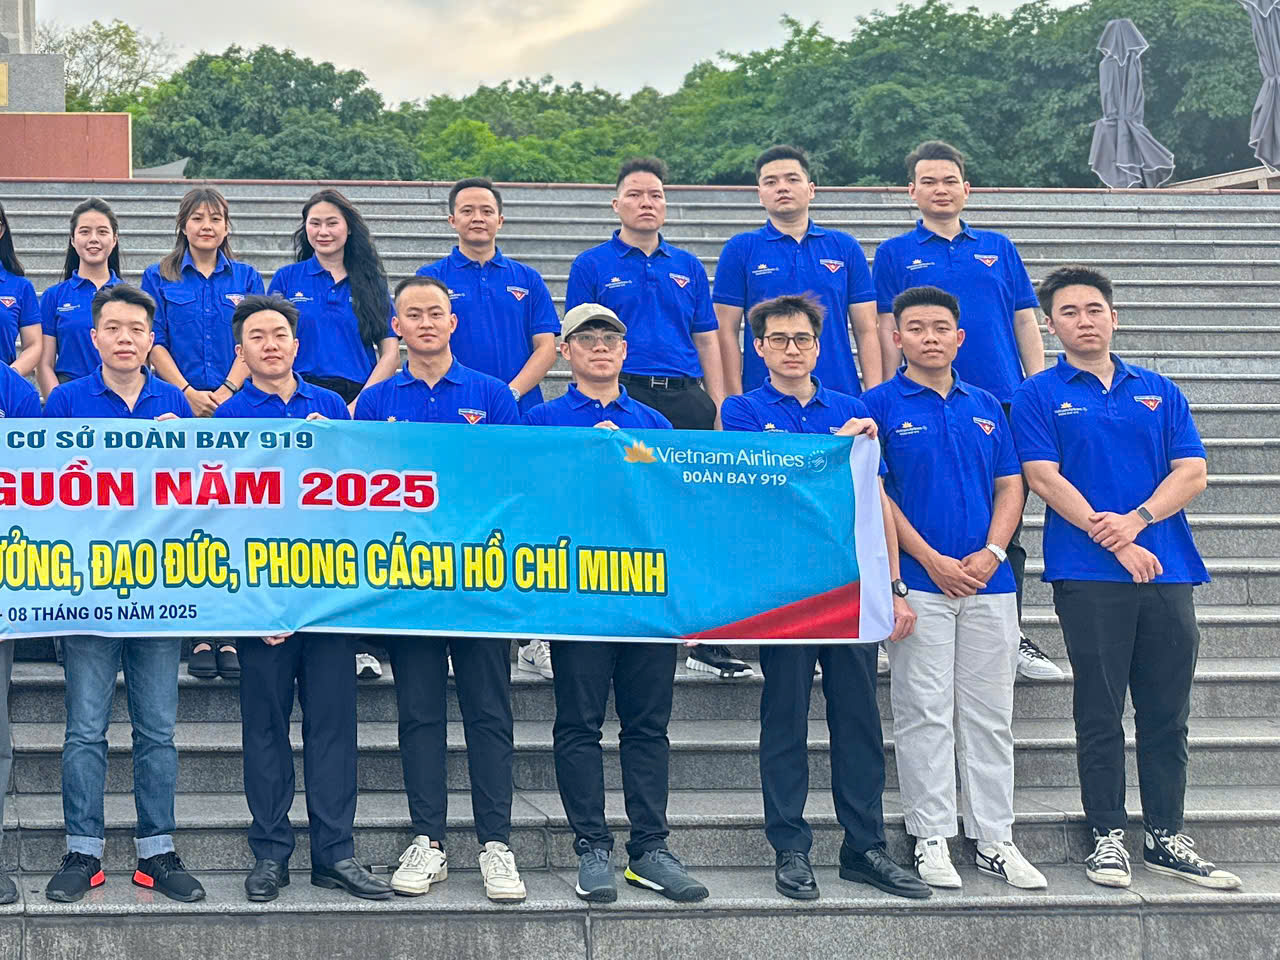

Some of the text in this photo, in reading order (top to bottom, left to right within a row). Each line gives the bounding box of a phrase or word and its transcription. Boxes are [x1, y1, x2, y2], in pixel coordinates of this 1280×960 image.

[6, 428, 46, 449] CƠ
[55, 424, 96, 450] SỞ
[103, 426, 186, 450] ĐOÀN
[195, 430, 250, 449] BAY
[259, 430, 314, 450] 919
[656, 446, 734, 466] Vietnam
[735, 449, 805, 468] Airlines
[153, 463, 282, 507] NĂM
[299, 471, 438, 510] 2025
[682, 468, 788, 486] ĐOÀN BAY 919
[91, 542, 152, 596] ĐẠO
[164, 533, 238, 590] ĐỨC,
[247, 542, 356, 588] PHONG
[366, 535, 455, 588] CÁCH
[464, 532, 506, 590] HỒ
[514, 540, 570, 592] CHÍ
[579, 548, 666, 594] MINH
[7, 606, 28, 622] 08
[31, 603, 89, 621] THÁNG
[93, 606, 114, 621] 05
[117, 603, 156, 620] NĂM
[158, 605, 198, 620] 2025
